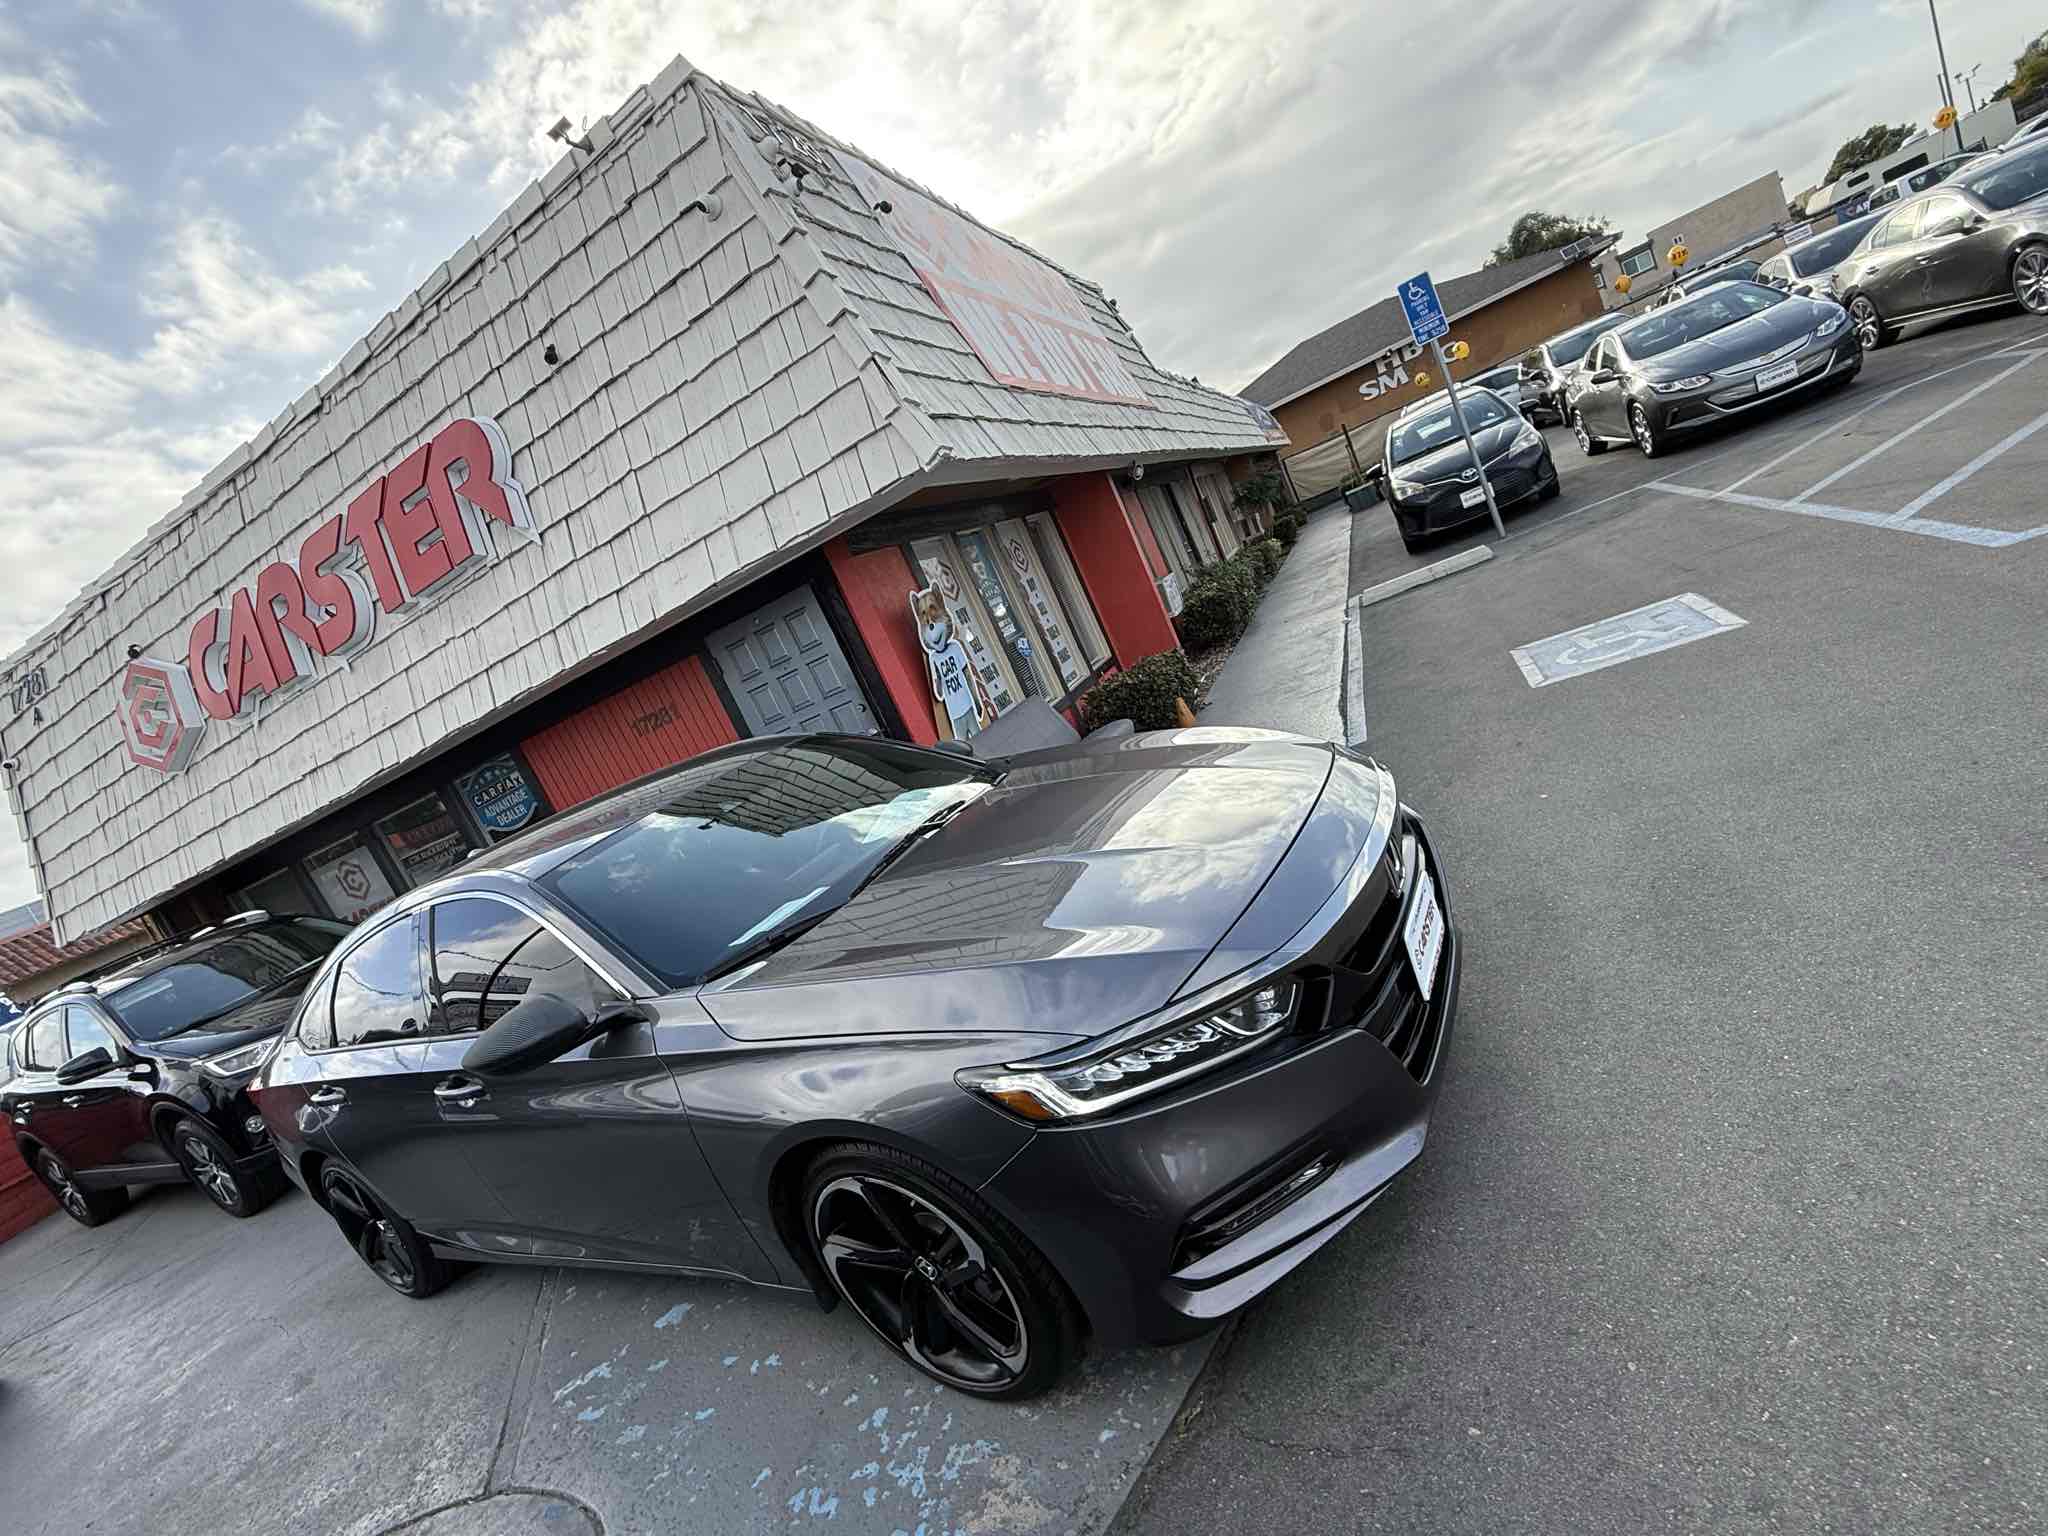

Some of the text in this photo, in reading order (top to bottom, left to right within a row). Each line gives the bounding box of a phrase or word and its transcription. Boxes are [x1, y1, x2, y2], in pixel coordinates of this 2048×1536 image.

[188, 416, 530, 722] CARSTER
[941, 655, 958, 678] CAR
[945, 673, 963, 695] FOX
[474, 770, 525, 806] CARFAX
[484, 789, 529, 817] ADVANTAGE
[496, 804, 528, 827] DEALER
